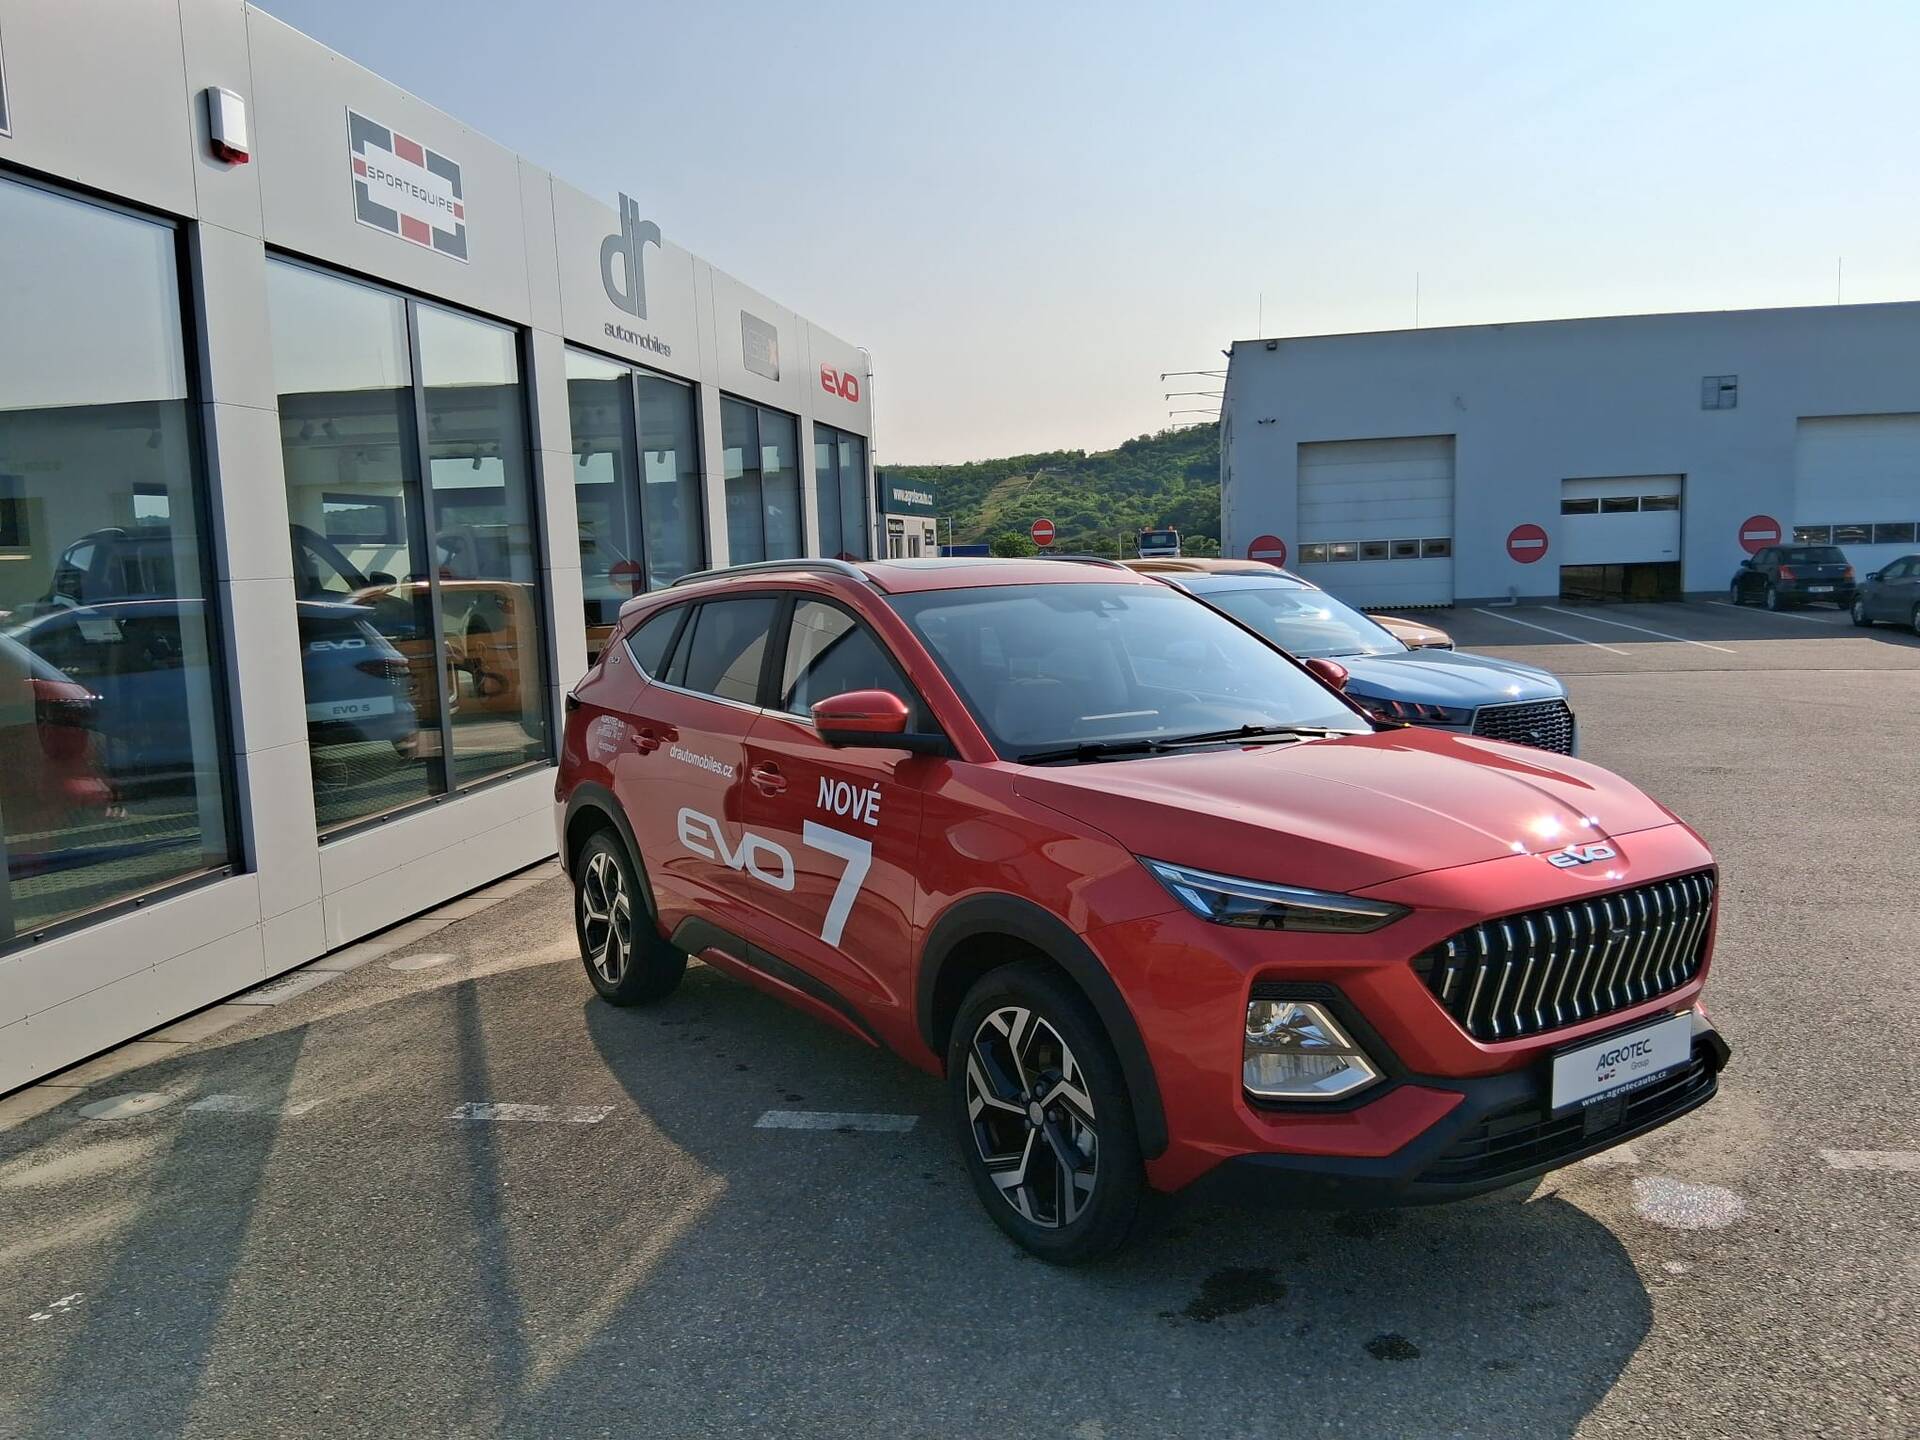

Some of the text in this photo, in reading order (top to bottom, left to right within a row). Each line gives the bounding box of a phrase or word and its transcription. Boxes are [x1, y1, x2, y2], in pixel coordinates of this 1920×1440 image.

[367, 165, 453, 214] SPORTEQUIPE
[600, 191, 662, 321] dr
[604, 322, 672, 358] automobiles
[820, 362, 860, 403] EVO
[310, 639, 366, 651] EVO
[332, 704, 358, 715] EVO
[670, 744, 734, 778] drautomobiles.cz
[816, 775, 882, 827] NOVÉ
[1547, 845, 1617, 869] EVO
[677, 807, 873, 947] EVO 7
[1596, 1038, 1653, 1071] AGROTEC
[1581, 1071, 1667, 1107] www.agrotecauto.cz
